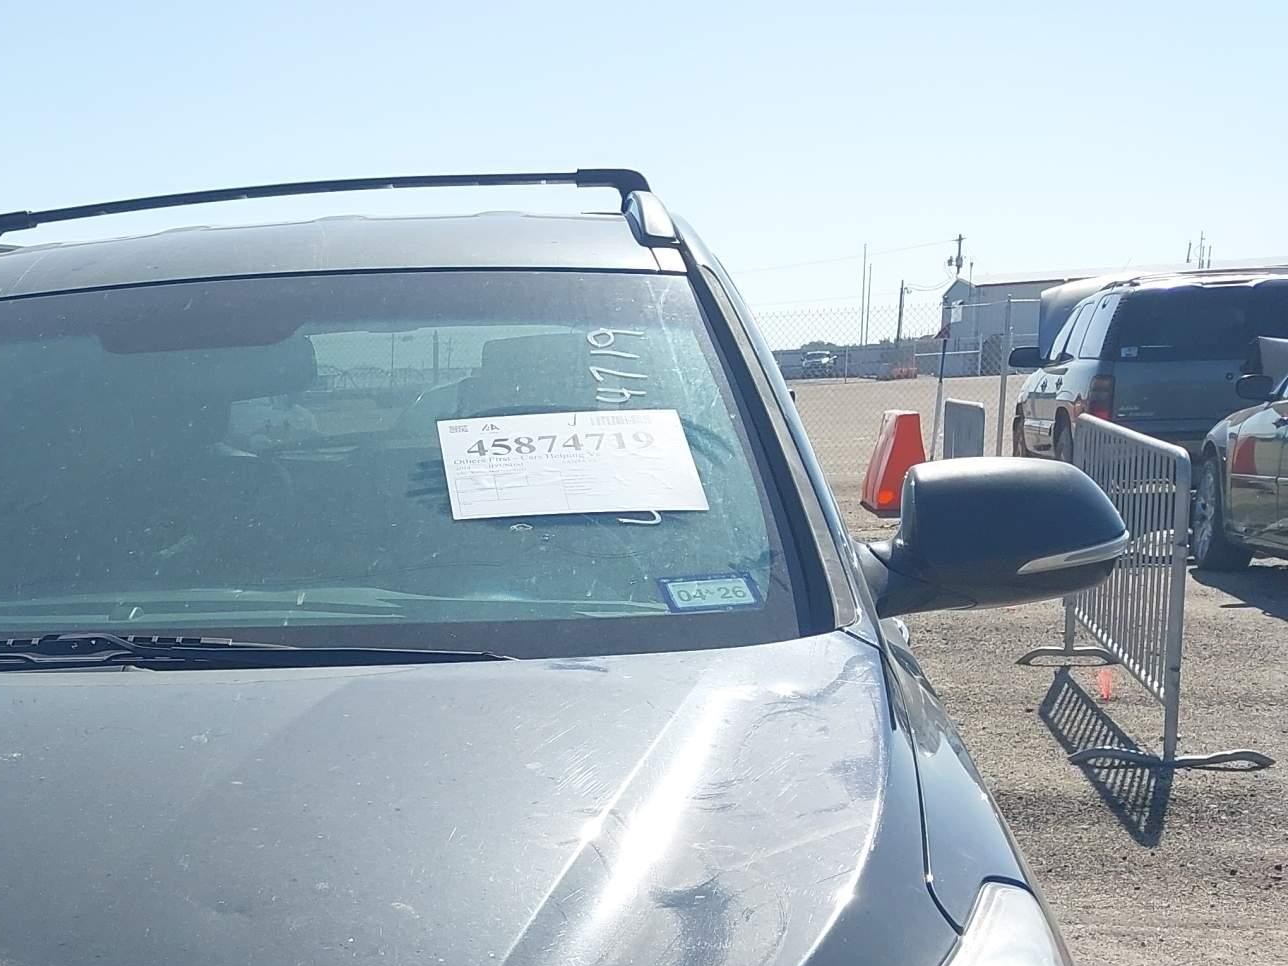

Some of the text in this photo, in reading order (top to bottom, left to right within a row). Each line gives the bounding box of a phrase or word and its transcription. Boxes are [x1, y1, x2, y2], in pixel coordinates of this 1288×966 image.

[587, 327, 648, 403] 4719
[466, 432, 655, 457] 45874719
[717, 586, 747, 600] 26
